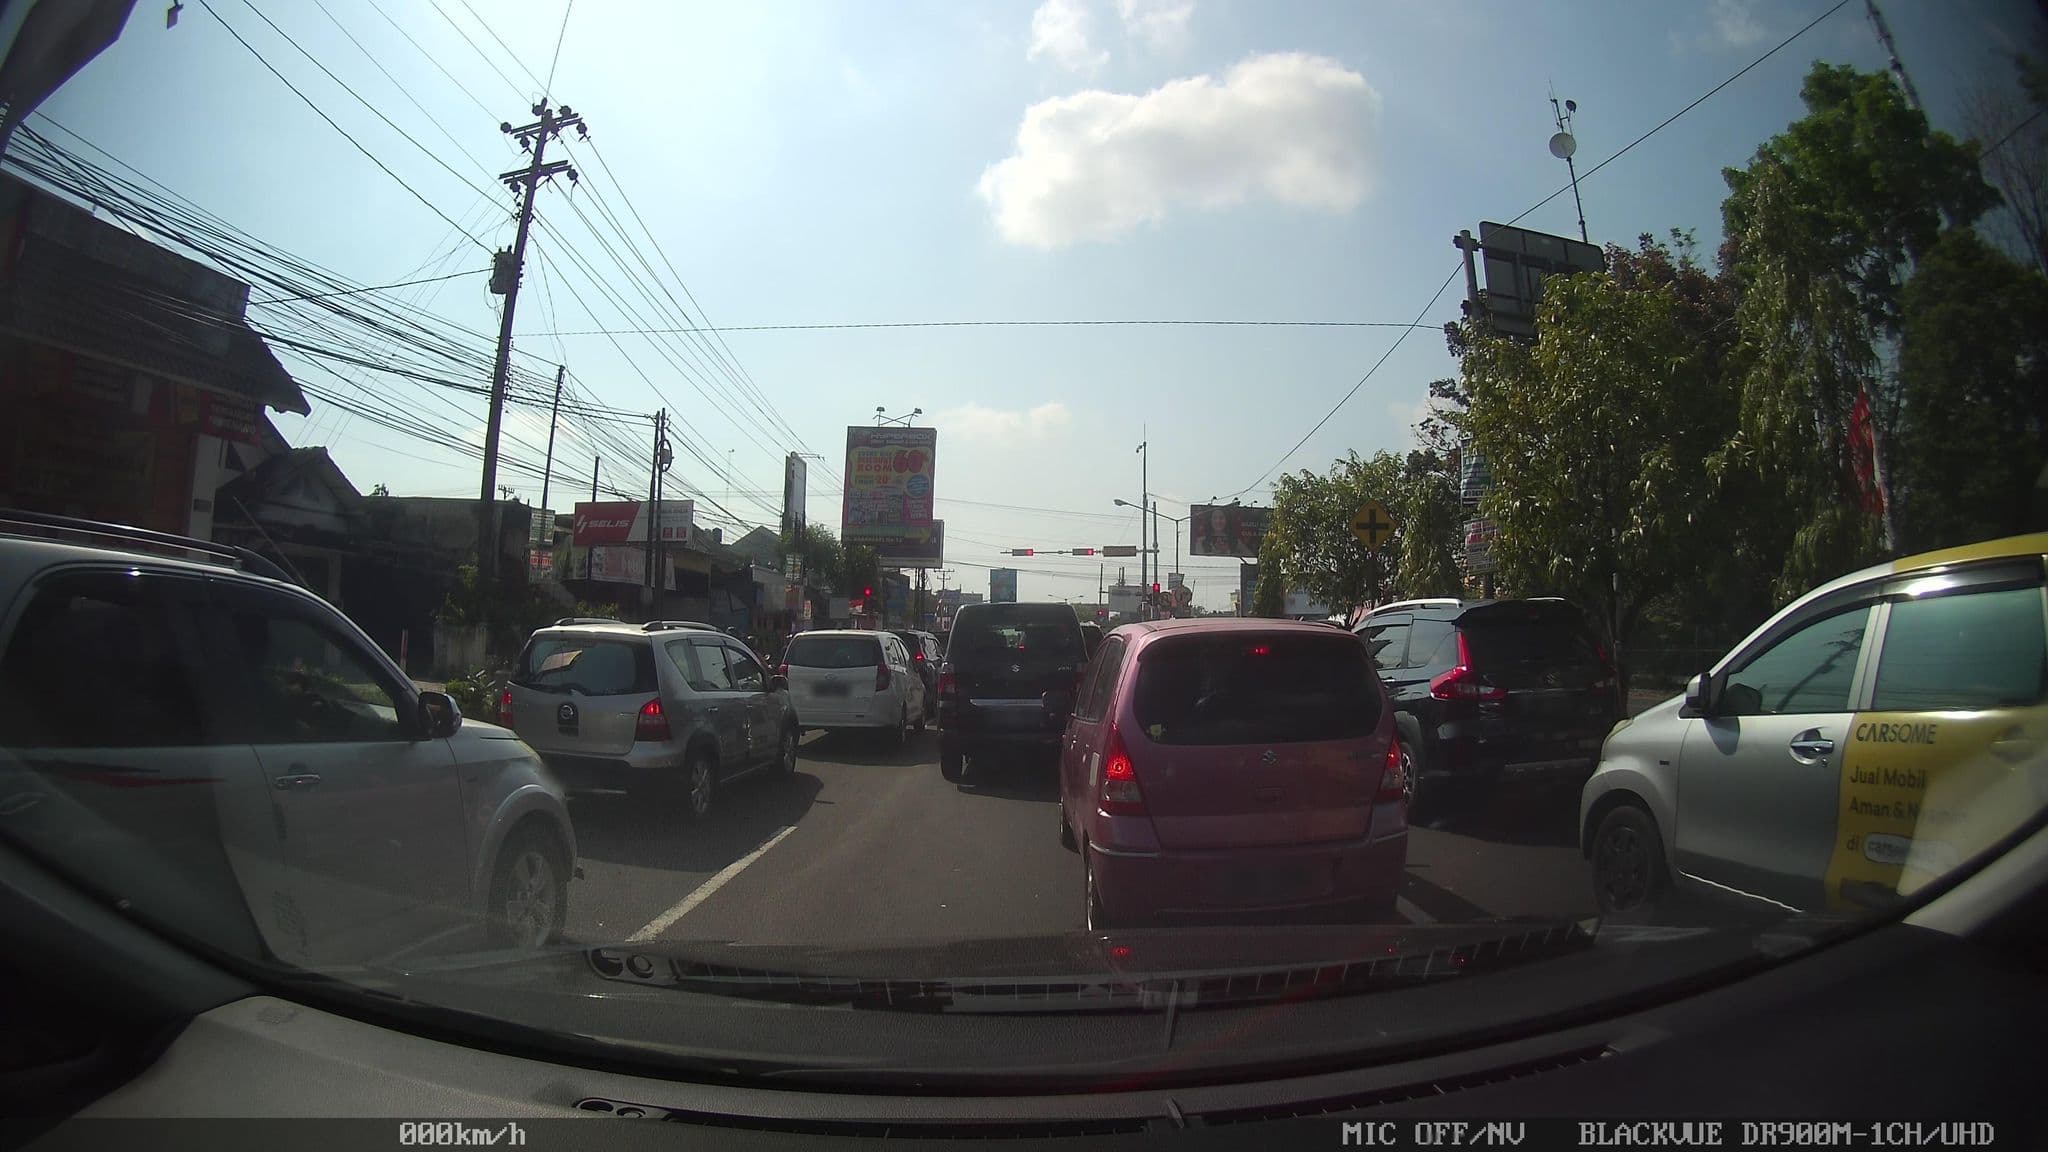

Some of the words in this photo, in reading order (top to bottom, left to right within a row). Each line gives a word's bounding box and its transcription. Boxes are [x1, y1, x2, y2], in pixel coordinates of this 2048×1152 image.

[857, 463, 892, 473] ROOM
[587, 518, 631, 528] SELIS
[1855, 722, 1938, 745] CARSOME
[1850, 765, 1880, 785] Jual
[1883, 768, 1927, 790] Mobil
[1848, 796, 1890, 818] Aman
[1892, 802, 1907, 818] &
[1846, 832, 1860, 851] di
